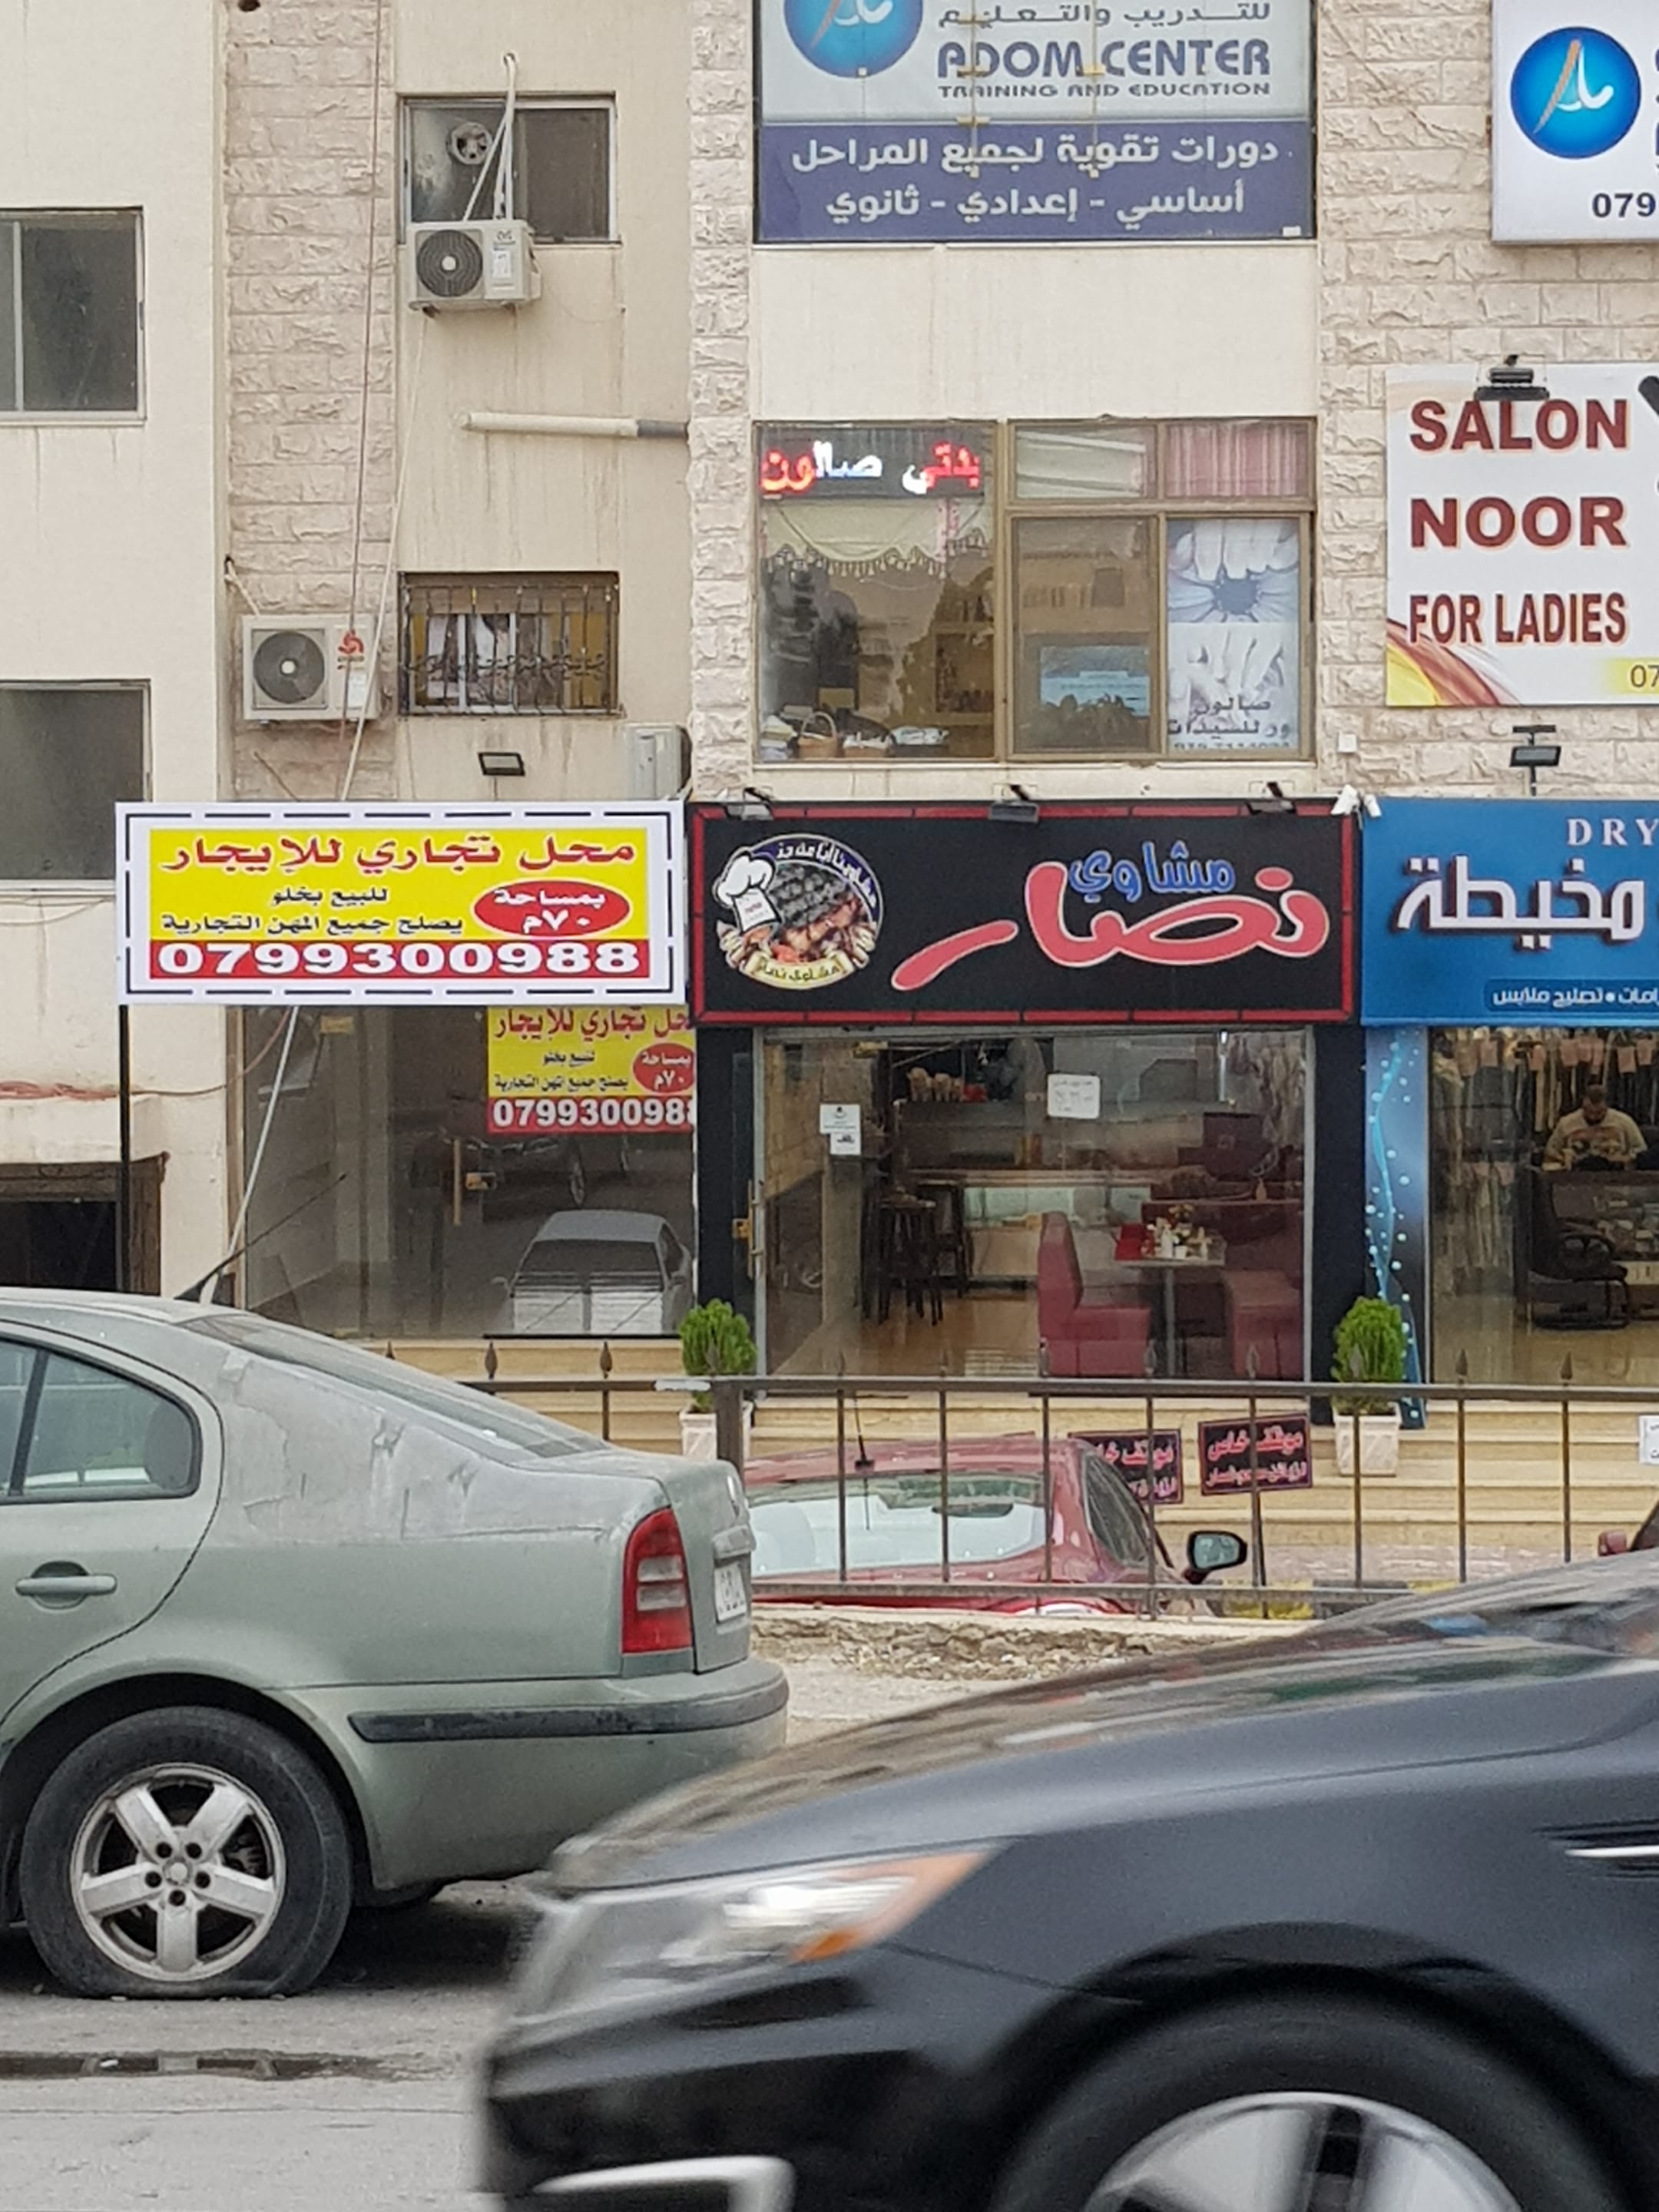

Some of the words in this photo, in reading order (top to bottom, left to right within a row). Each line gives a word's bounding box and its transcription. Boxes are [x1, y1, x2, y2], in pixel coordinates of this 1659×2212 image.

[938, 40, 1083, 78] ADOM
[1101, 38, 1270, 77] CENTER
[938, 84, 1058, 98] TRAINING
[1068, 84, 1119, 97] AND
[1128, 82, 1270, 96] EDUCATION
[792, 137, 928, 173] المراحل
[942, 136, 1045, 174] لجميع
[1057, 135, 1160, 172] تقوية
[1171, 137, 1279, 169] دورات
[826, 184, 919, 223] ثانوي
[957, 188, 1078, 223] إعدادي
[1115, 179, 1244, 230] أساسي
[1592, 193, 1656, 217] 079
[1409, 399, 1628, 452] SALON
[760, 440, 882, 492] صالون
[1411, 496, 1628, 548] NOOR
[1409, 594, 1482, 644] FOR
[1495, 592, 1627, 644] LADIES
[1567, 819, 1659, 846] DRY
[356, 833, 501, 875] تجاري
[519, 838, 634, 870] محل
[1069, 839, 1237, 902] مشاوي
[271, 886, 322, 906] بخلو
[331, 888, 387, 907] للبيع
[495, 889, 605, 909] بمساحة
[1397, 855, 1645, 949] مخيطة
[161, 913, 259, 935] التجارية
[327, 917, 389, 935] جميع
[398, 914, 462, 934] يصلح
[890, 862, 1330, 991] نصار
[157, 942, 641, 975] 0799300988
[1492, 988, 1550, 1006] ملابس
[581, 1006, 647, 1041] تجاري
